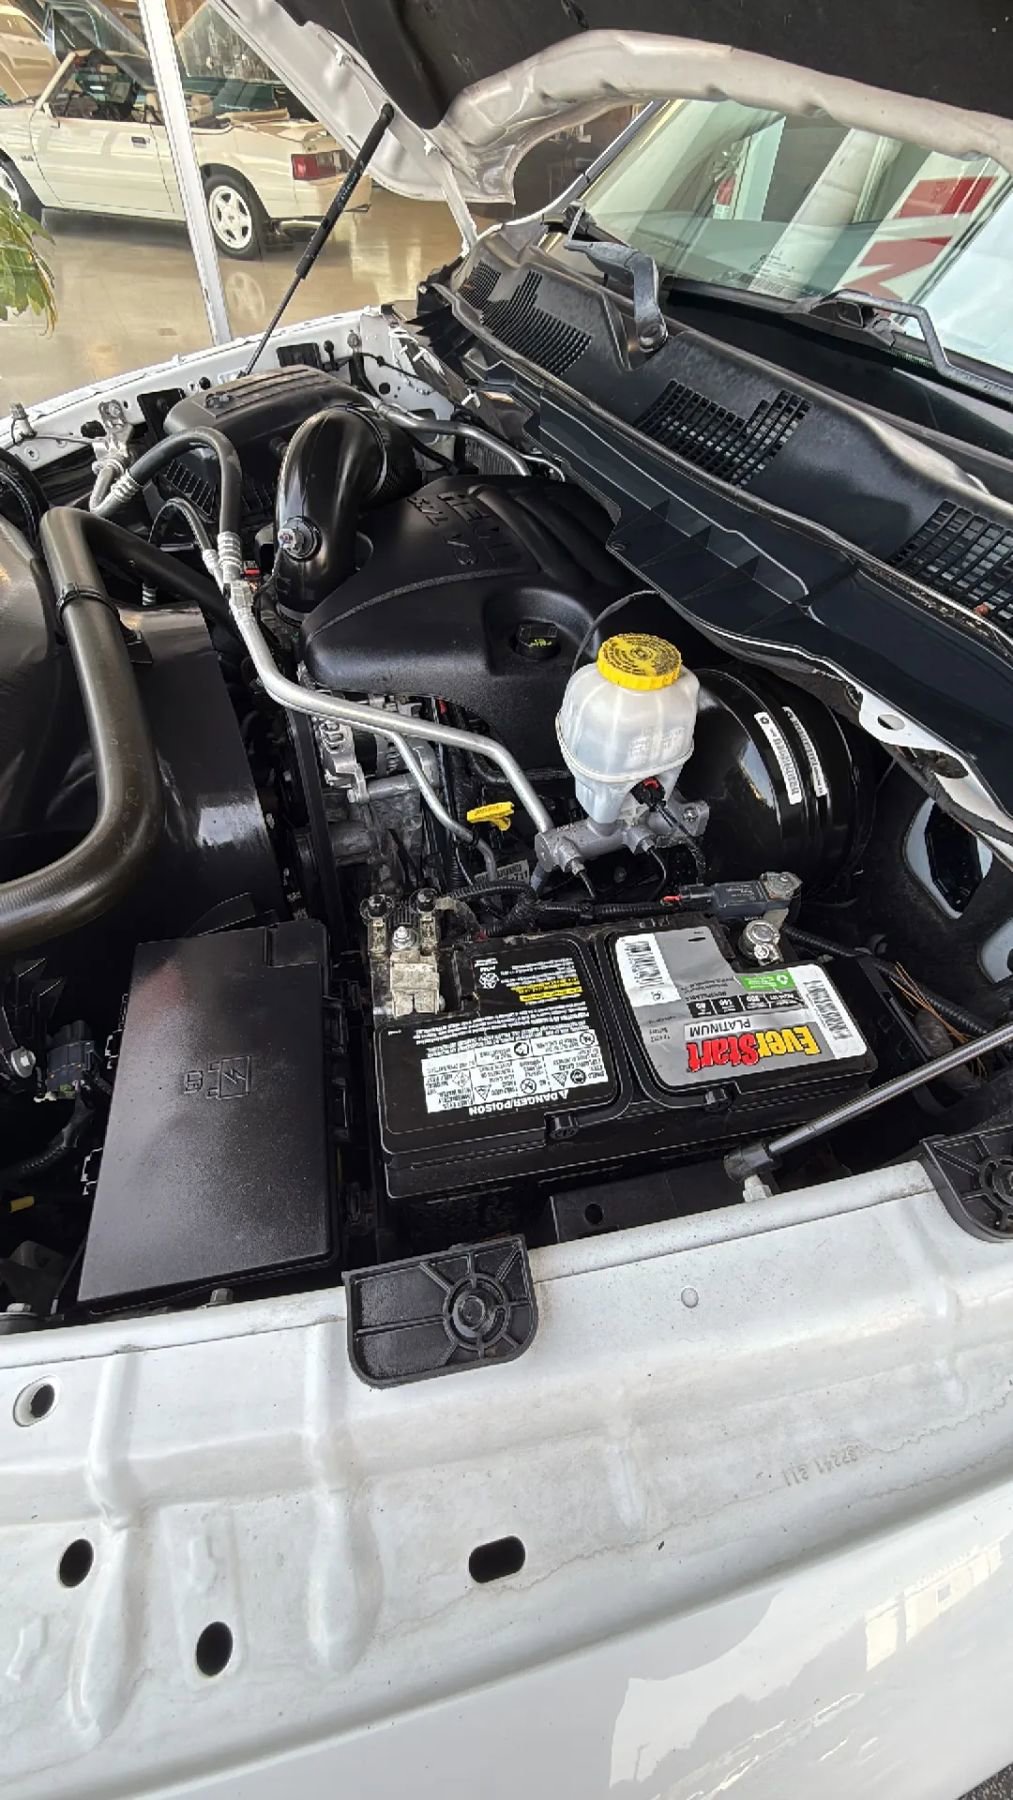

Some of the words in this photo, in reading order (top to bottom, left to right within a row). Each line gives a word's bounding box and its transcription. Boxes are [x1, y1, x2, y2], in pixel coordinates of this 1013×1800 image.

[690, 1018, 751, 1037] PLATINUM
[686, 1025, 821, 1074] EverStart
[469, 1092, 558, 1116] DANGER/POISON
